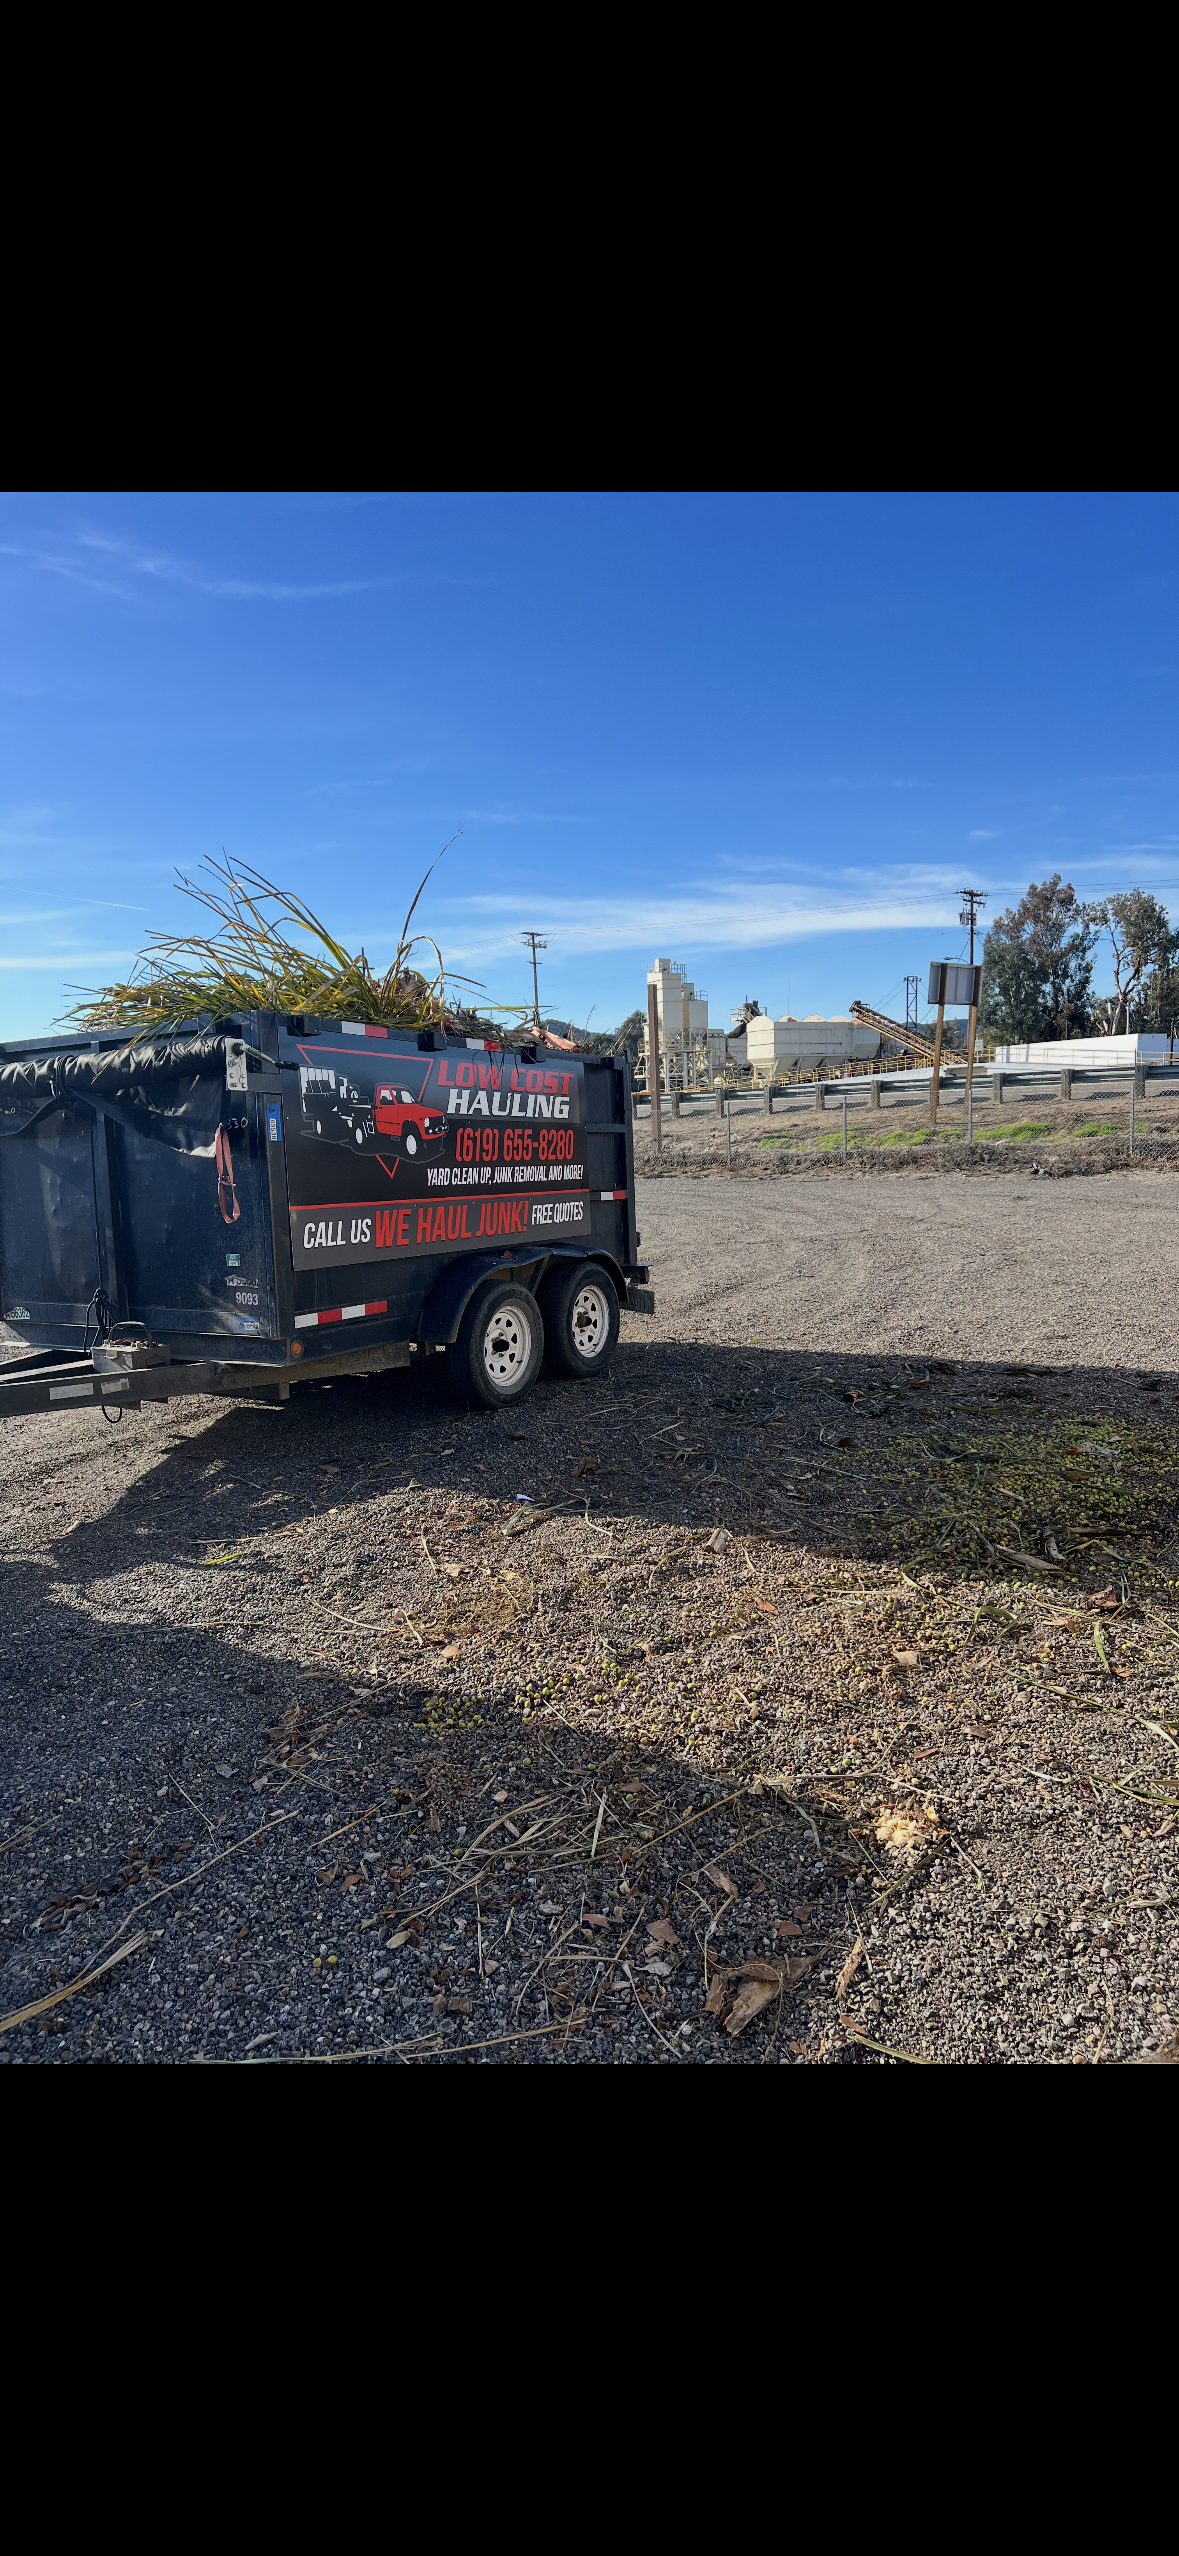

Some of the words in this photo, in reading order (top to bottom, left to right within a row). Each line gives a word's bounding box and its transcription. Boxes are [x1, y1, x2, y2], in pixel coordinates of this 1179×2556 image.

[437, 1060, 505, 1090] LOW
[510, 1068, 574, 1095] COST
[447, 1088, 570, 1119] HAULING
[455, 1127, 499, 1162] (619)
[503, 1128, 574, 1162] 655-8280
[427, 1167, 451, 1186] YARD
[451, 1166, 479, 1185] CLEAN
[480, 1166, 491, 1186] UP,
[493, 1166, 513, 1184] JUNK
[514, 1165, 547, 1183] REMOVAL
[548, 1165, 563, 1181] AND
[563, 1164, 584, 1180] MORE!
[303, 1220, 346, 1249] CALL
[350, 1218, 372, 1244] US
[375, 1208, 412, 1248] WE
[416, 1204, 472, 1244] HAUL
[475, 1200, 529, 1237] JUNK!
[531, 1202, 553, 1226] FREE
[553, 1201, 584, 1224] QUOTES
[235, 1291, 259, 1306] 9093
